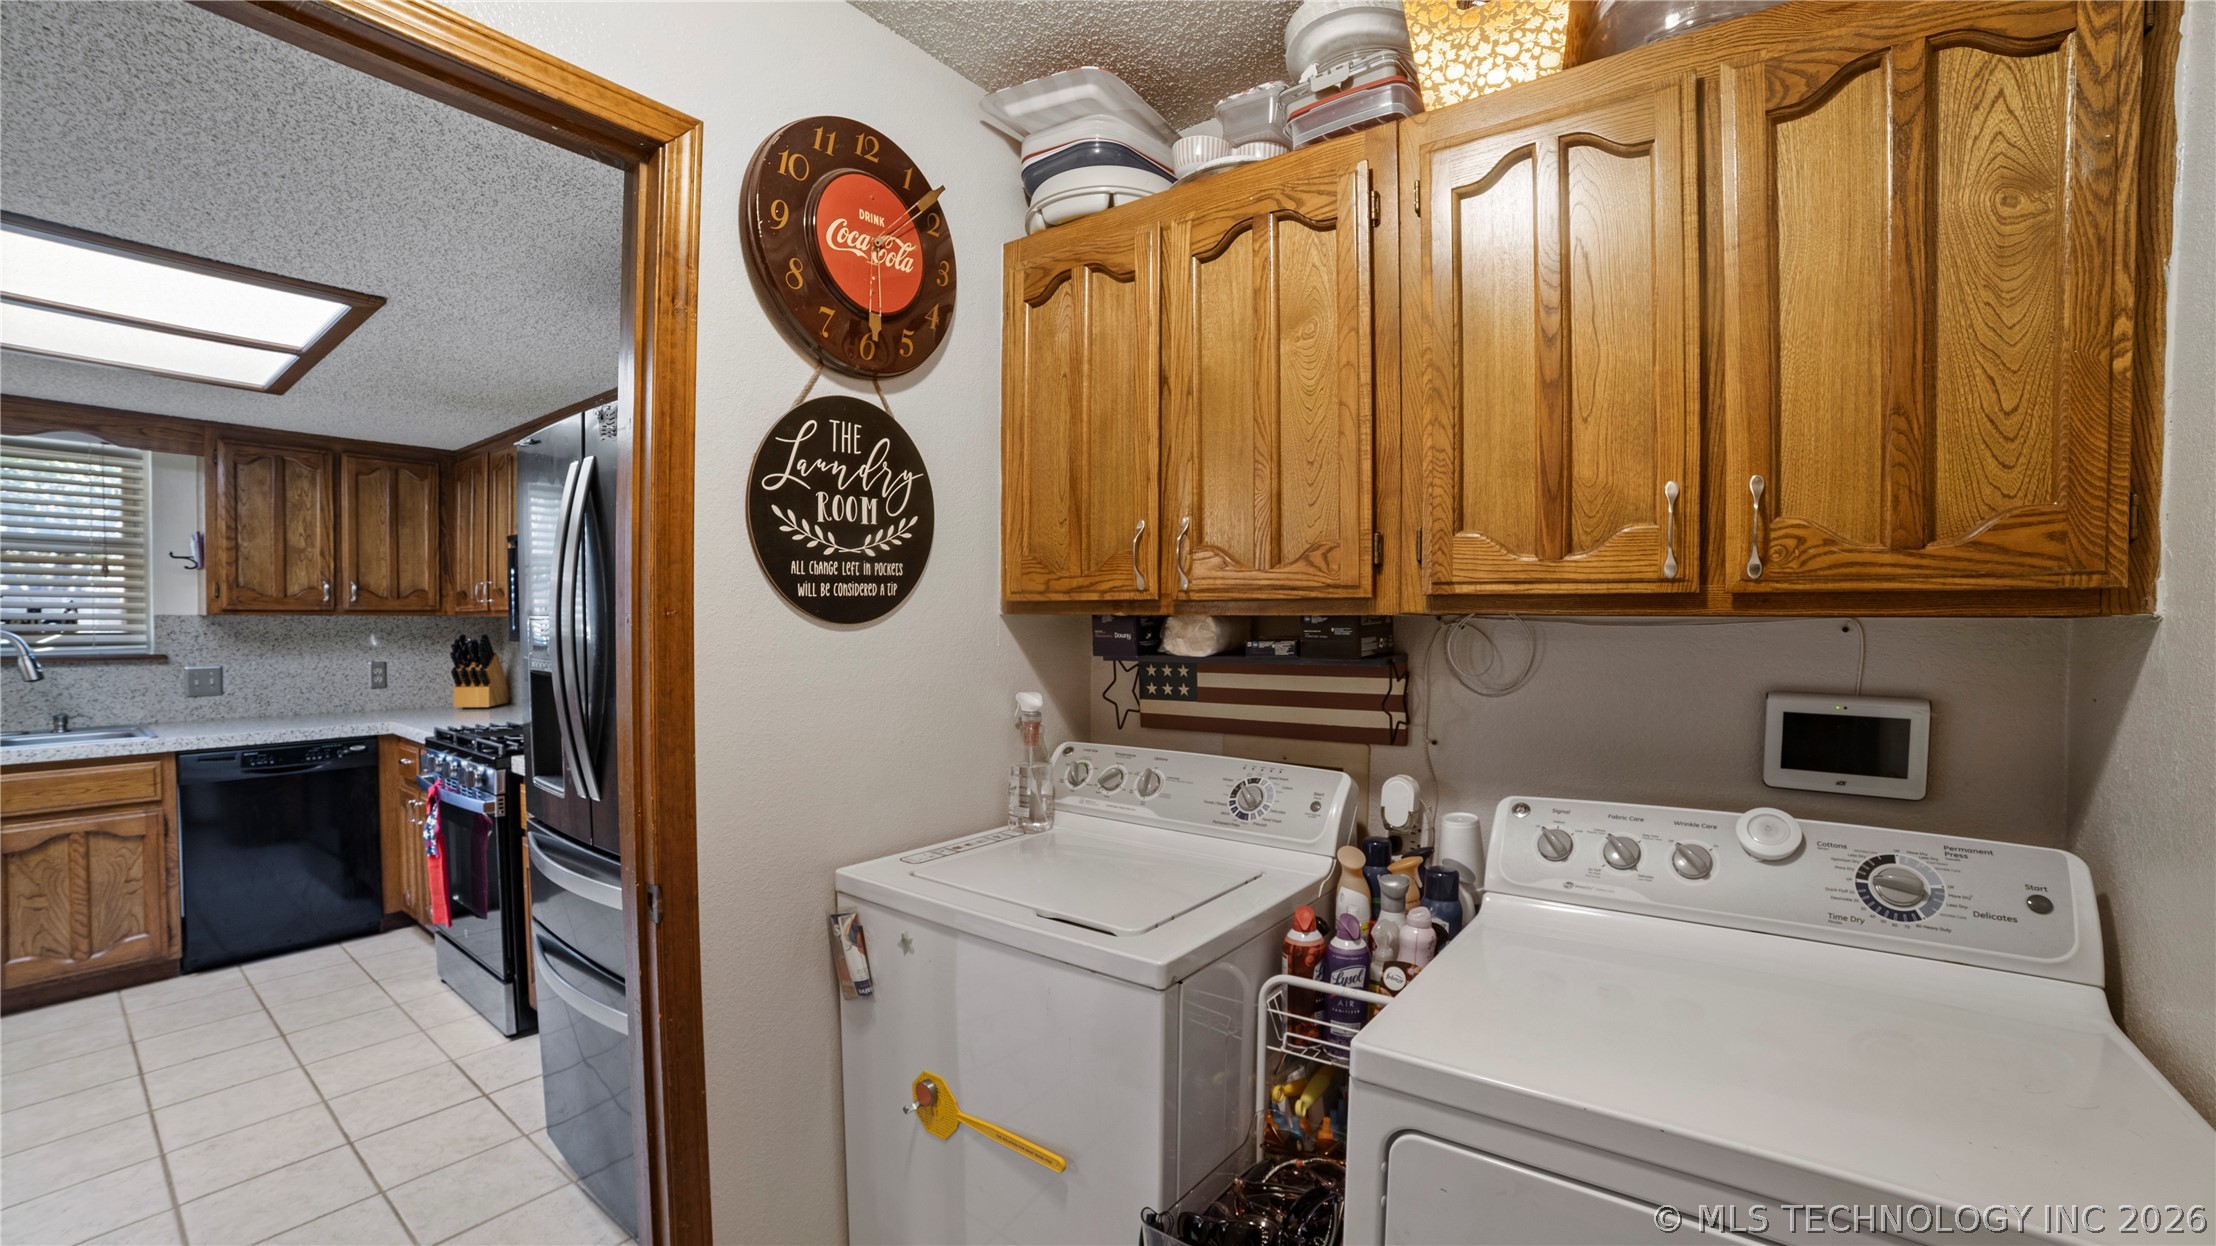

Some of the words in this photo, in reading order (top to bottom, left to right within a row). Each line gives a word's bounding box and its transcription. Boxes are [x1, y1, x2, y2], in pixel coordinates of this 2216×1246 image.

[812, 126, 837, 156] 11
[854, 132, 880, 163] 12
[777, 149, 810, 181] 10
[902, 167, 914, 190] 1
[770, 199, 789, 230] 9
[858, 208, 885, 228] DRINK
[927, 212, 941, 237] 2
[785, 257, 804, 290] 8
[936, 260, 950, 287] 3
[818, 306, 836, 338] 7
[924, 303, 940, 329] 4
[859, 332, 876, 361] 6
[900, 329, 915, 357] 5
[829, 419, 862, 454] THE
[761, 419, 924, 517] Laundry
[815, 491, 879, 525] ROOM
[791, 560, 806, 575] ALL
[880, 583, 885, 596] A
[1674, 820, 1700, 828] Wrinkle
[1816, 841, 1847, 850] Cottons
[1943, 845, 1994, 856] Permanent
[1944, 851, 1969, 859] Press
[2024, 883, 2049, 893] Start
[1828, 912, 1849, 921] Time
[1850, 915, 1866, 925] Dry
[1972, 910, 2019, 923] Delicates
[1332, 968, 1364, 987] Lysol
[1338, 1000, 1355, 1008] AIR
